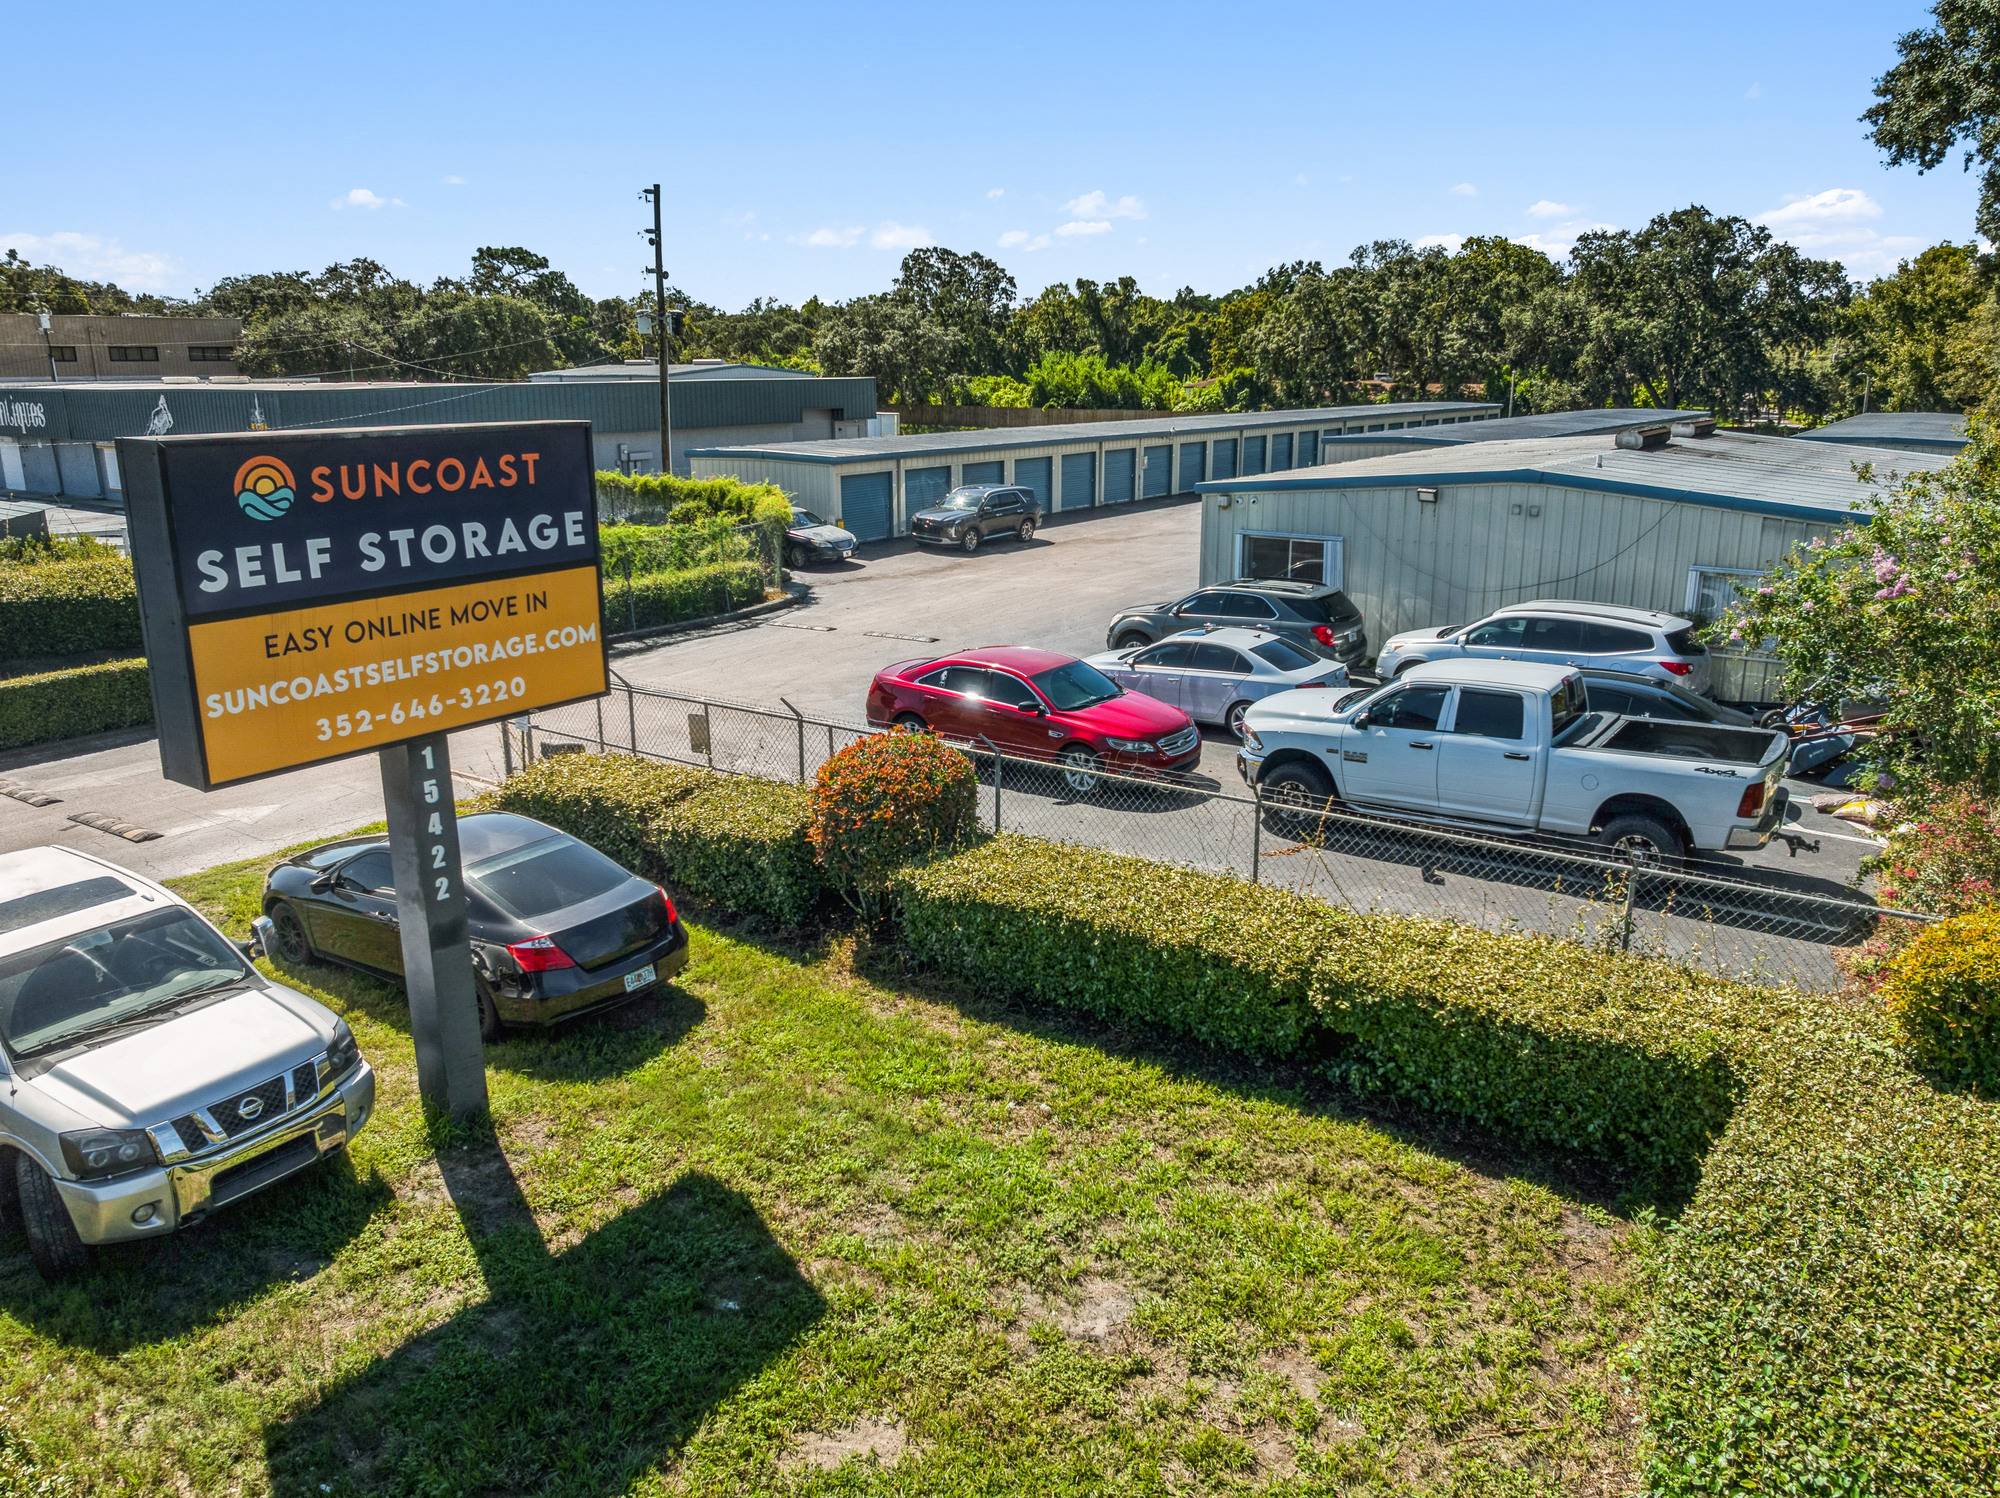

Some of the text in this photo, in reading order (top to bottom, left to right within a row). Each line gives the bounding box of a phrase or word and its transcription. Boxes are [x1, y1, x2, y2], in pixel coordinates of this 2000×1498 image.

[310, 452, 541, 503] SUNCOAST
[197, 511, 586, 594] SELF STORAGE
[264, 590, 548, 659] EASY ONLINE MOVE IN
[206, 622, 597, 719] SUNCOASTSELFSTORAGE.COM
[316, 676, 527, 742] 352-646-3220
[421, 746, 450, 900] 15422
